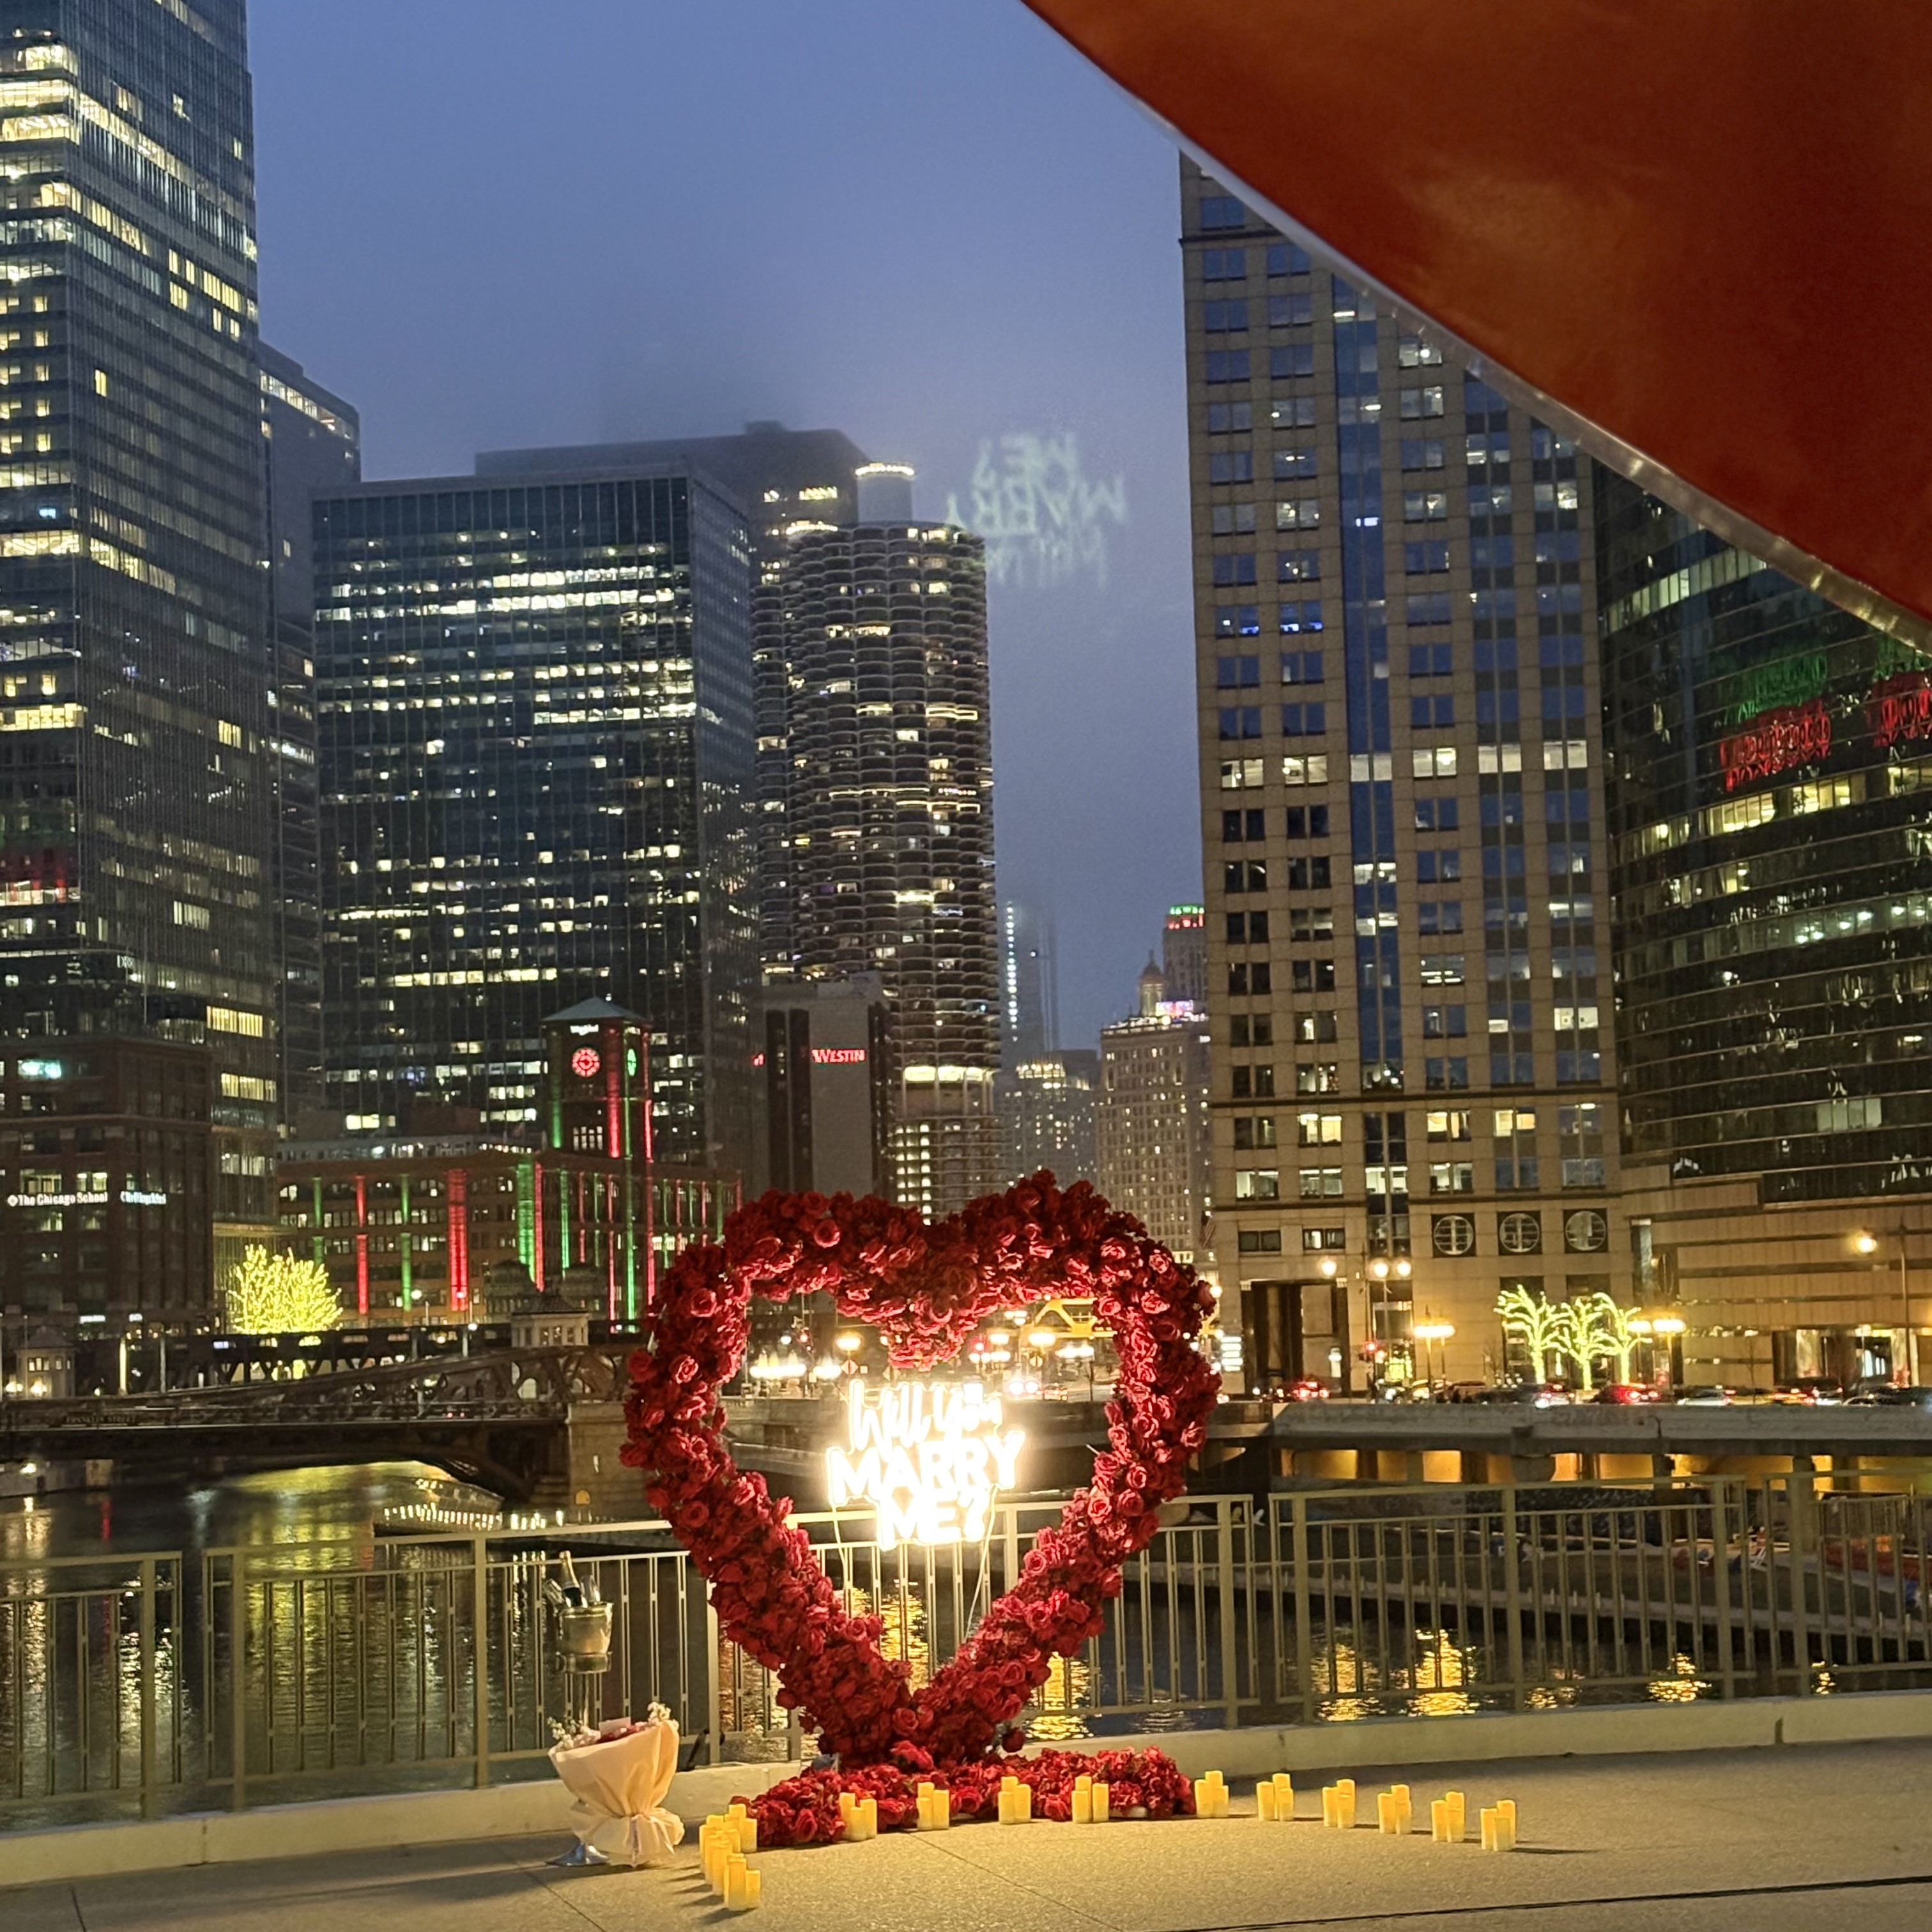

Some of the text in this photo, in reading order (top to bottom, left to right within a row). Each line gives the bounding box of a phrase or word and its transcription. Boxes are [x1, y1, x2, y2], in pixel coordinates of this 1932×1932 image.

[811, 1049, 865, 1063] WESTIN
[18, 1194, 35, 1206] The
[37, 1193, 75, 1206] Chicago
[77, 1192, 108, 1204] School
[829, 1431, 1025, 1503] MARRY
[878, 1487, 992, 1551] ME?
